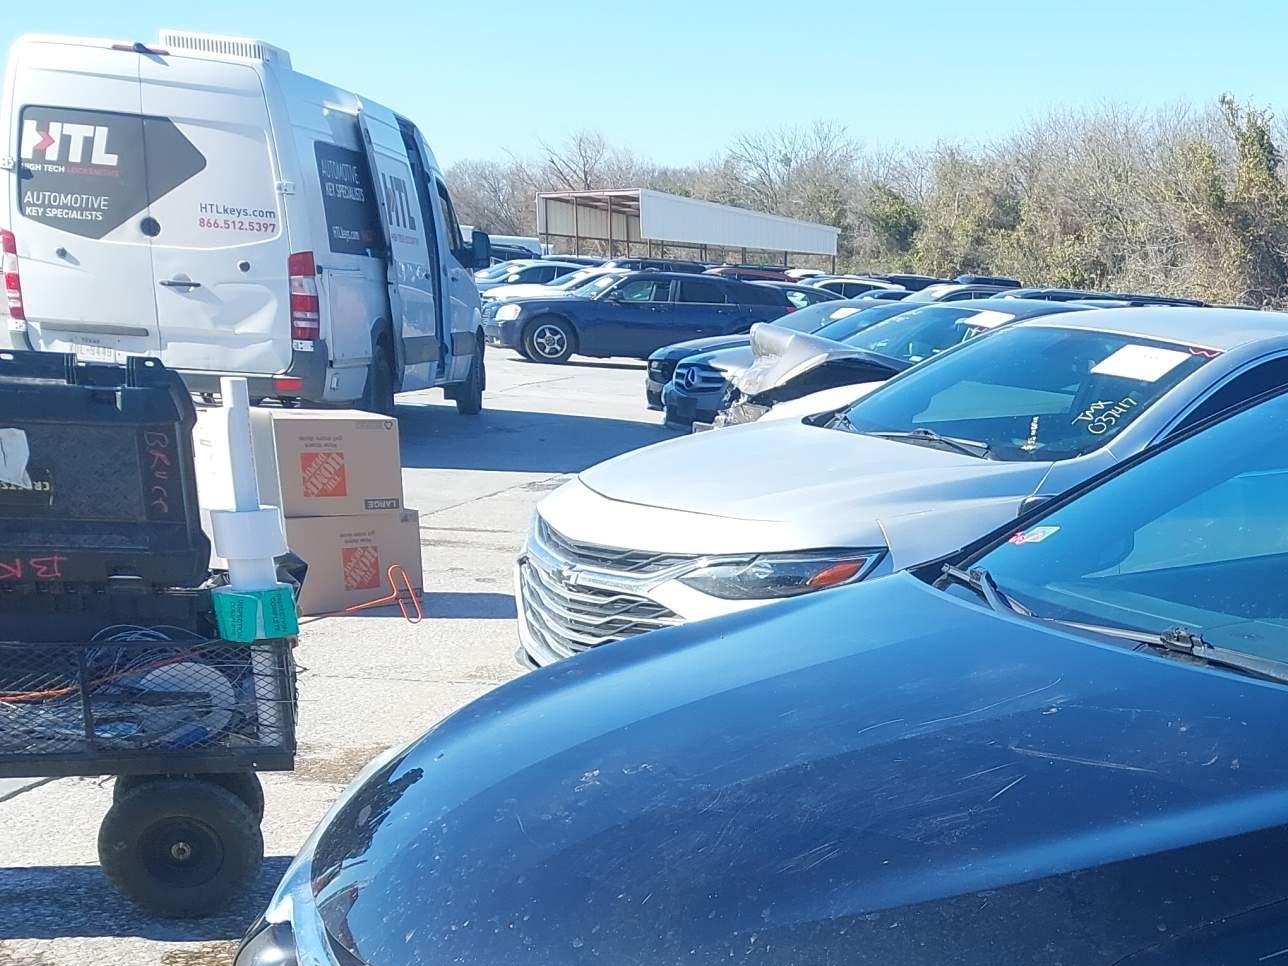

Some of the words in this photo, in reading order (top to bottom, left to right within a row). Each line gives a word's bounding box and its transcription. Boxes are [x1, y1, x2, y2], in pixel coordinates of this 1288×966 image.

[20, 119, 119, 166] HTL
[44, 164, 65, 173] TECH
[23, 191, 111, 210] AUTOMOTIVE
[25, 206, 44, 217] KEY
[46, 207, 103, 221] SPECIALISTS
[199, 202, 276, 218] HTLkeys.com
[198, 217, 276, 233] 866.512.5397
[367, 500, 398, 508] LARGE
